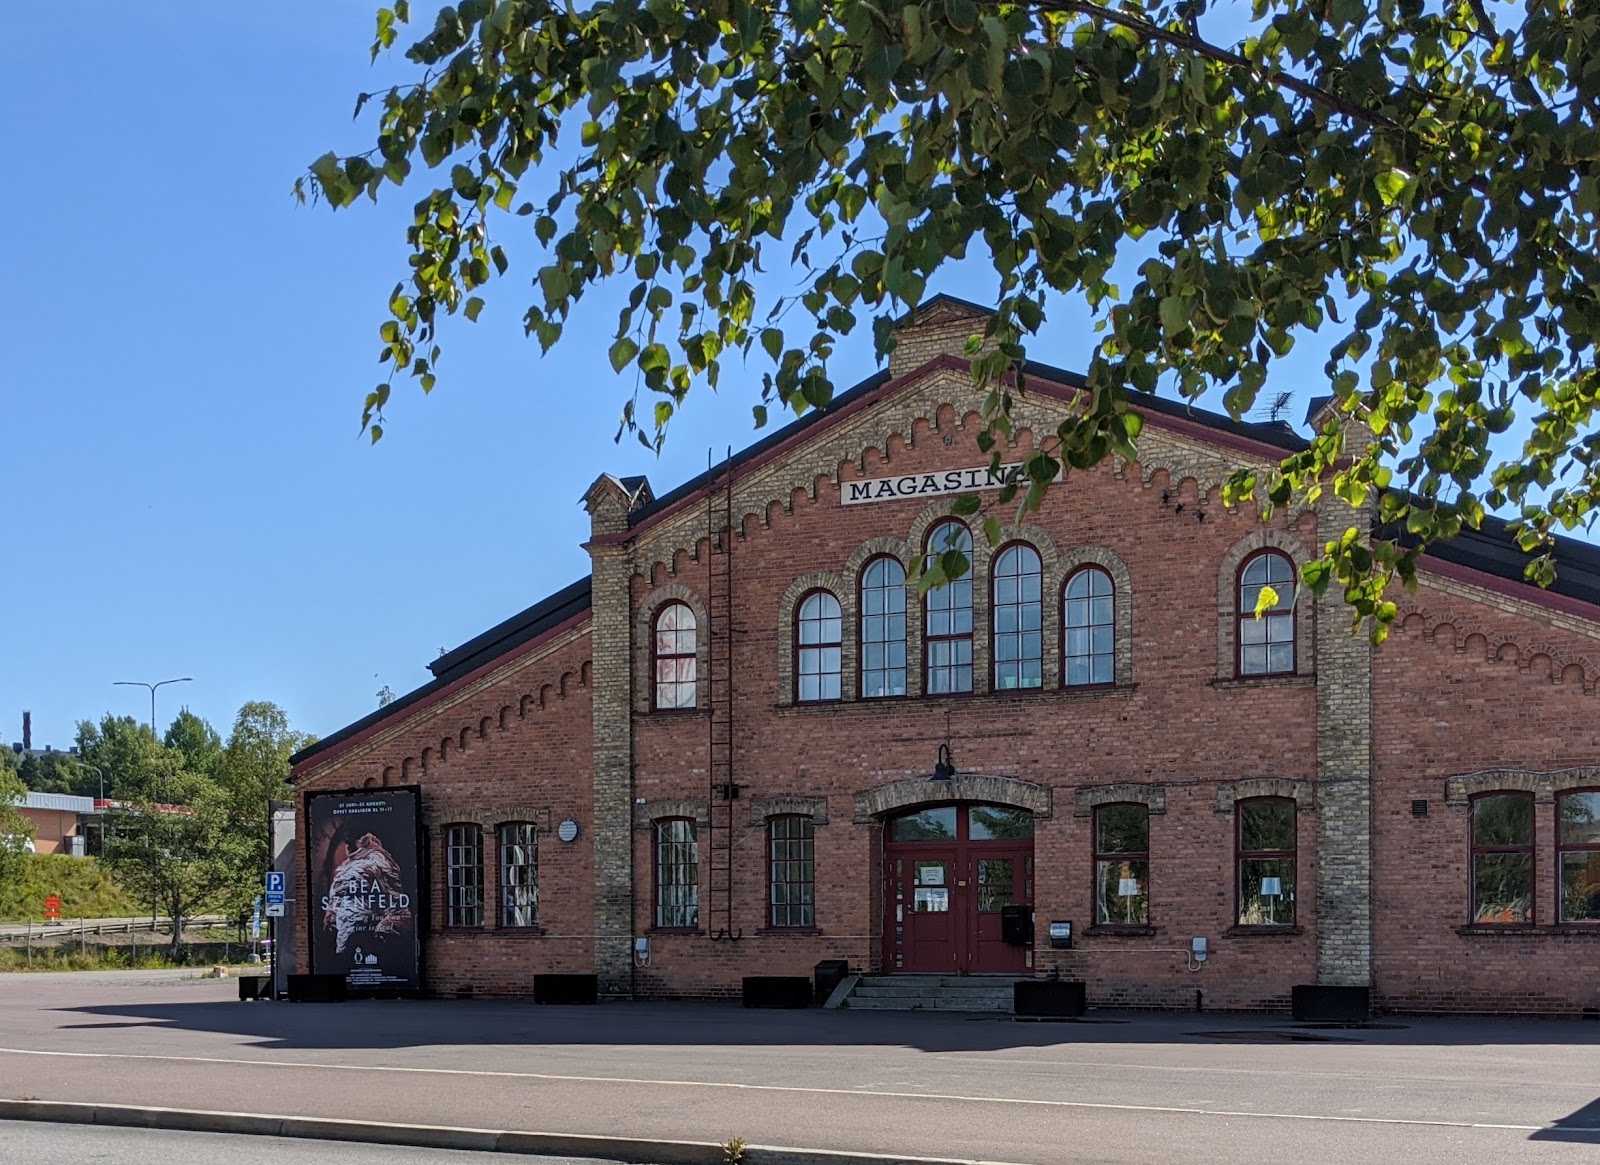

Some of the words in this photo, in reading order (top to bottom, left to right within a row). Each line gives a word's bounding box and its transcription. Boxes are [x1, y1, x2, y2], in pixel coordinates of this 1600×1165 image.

[849, 464, 1040, 500] MAGASIN
[349, 879, 381, 894] BEA
[321, 893, 410, 911] SZENFELD
